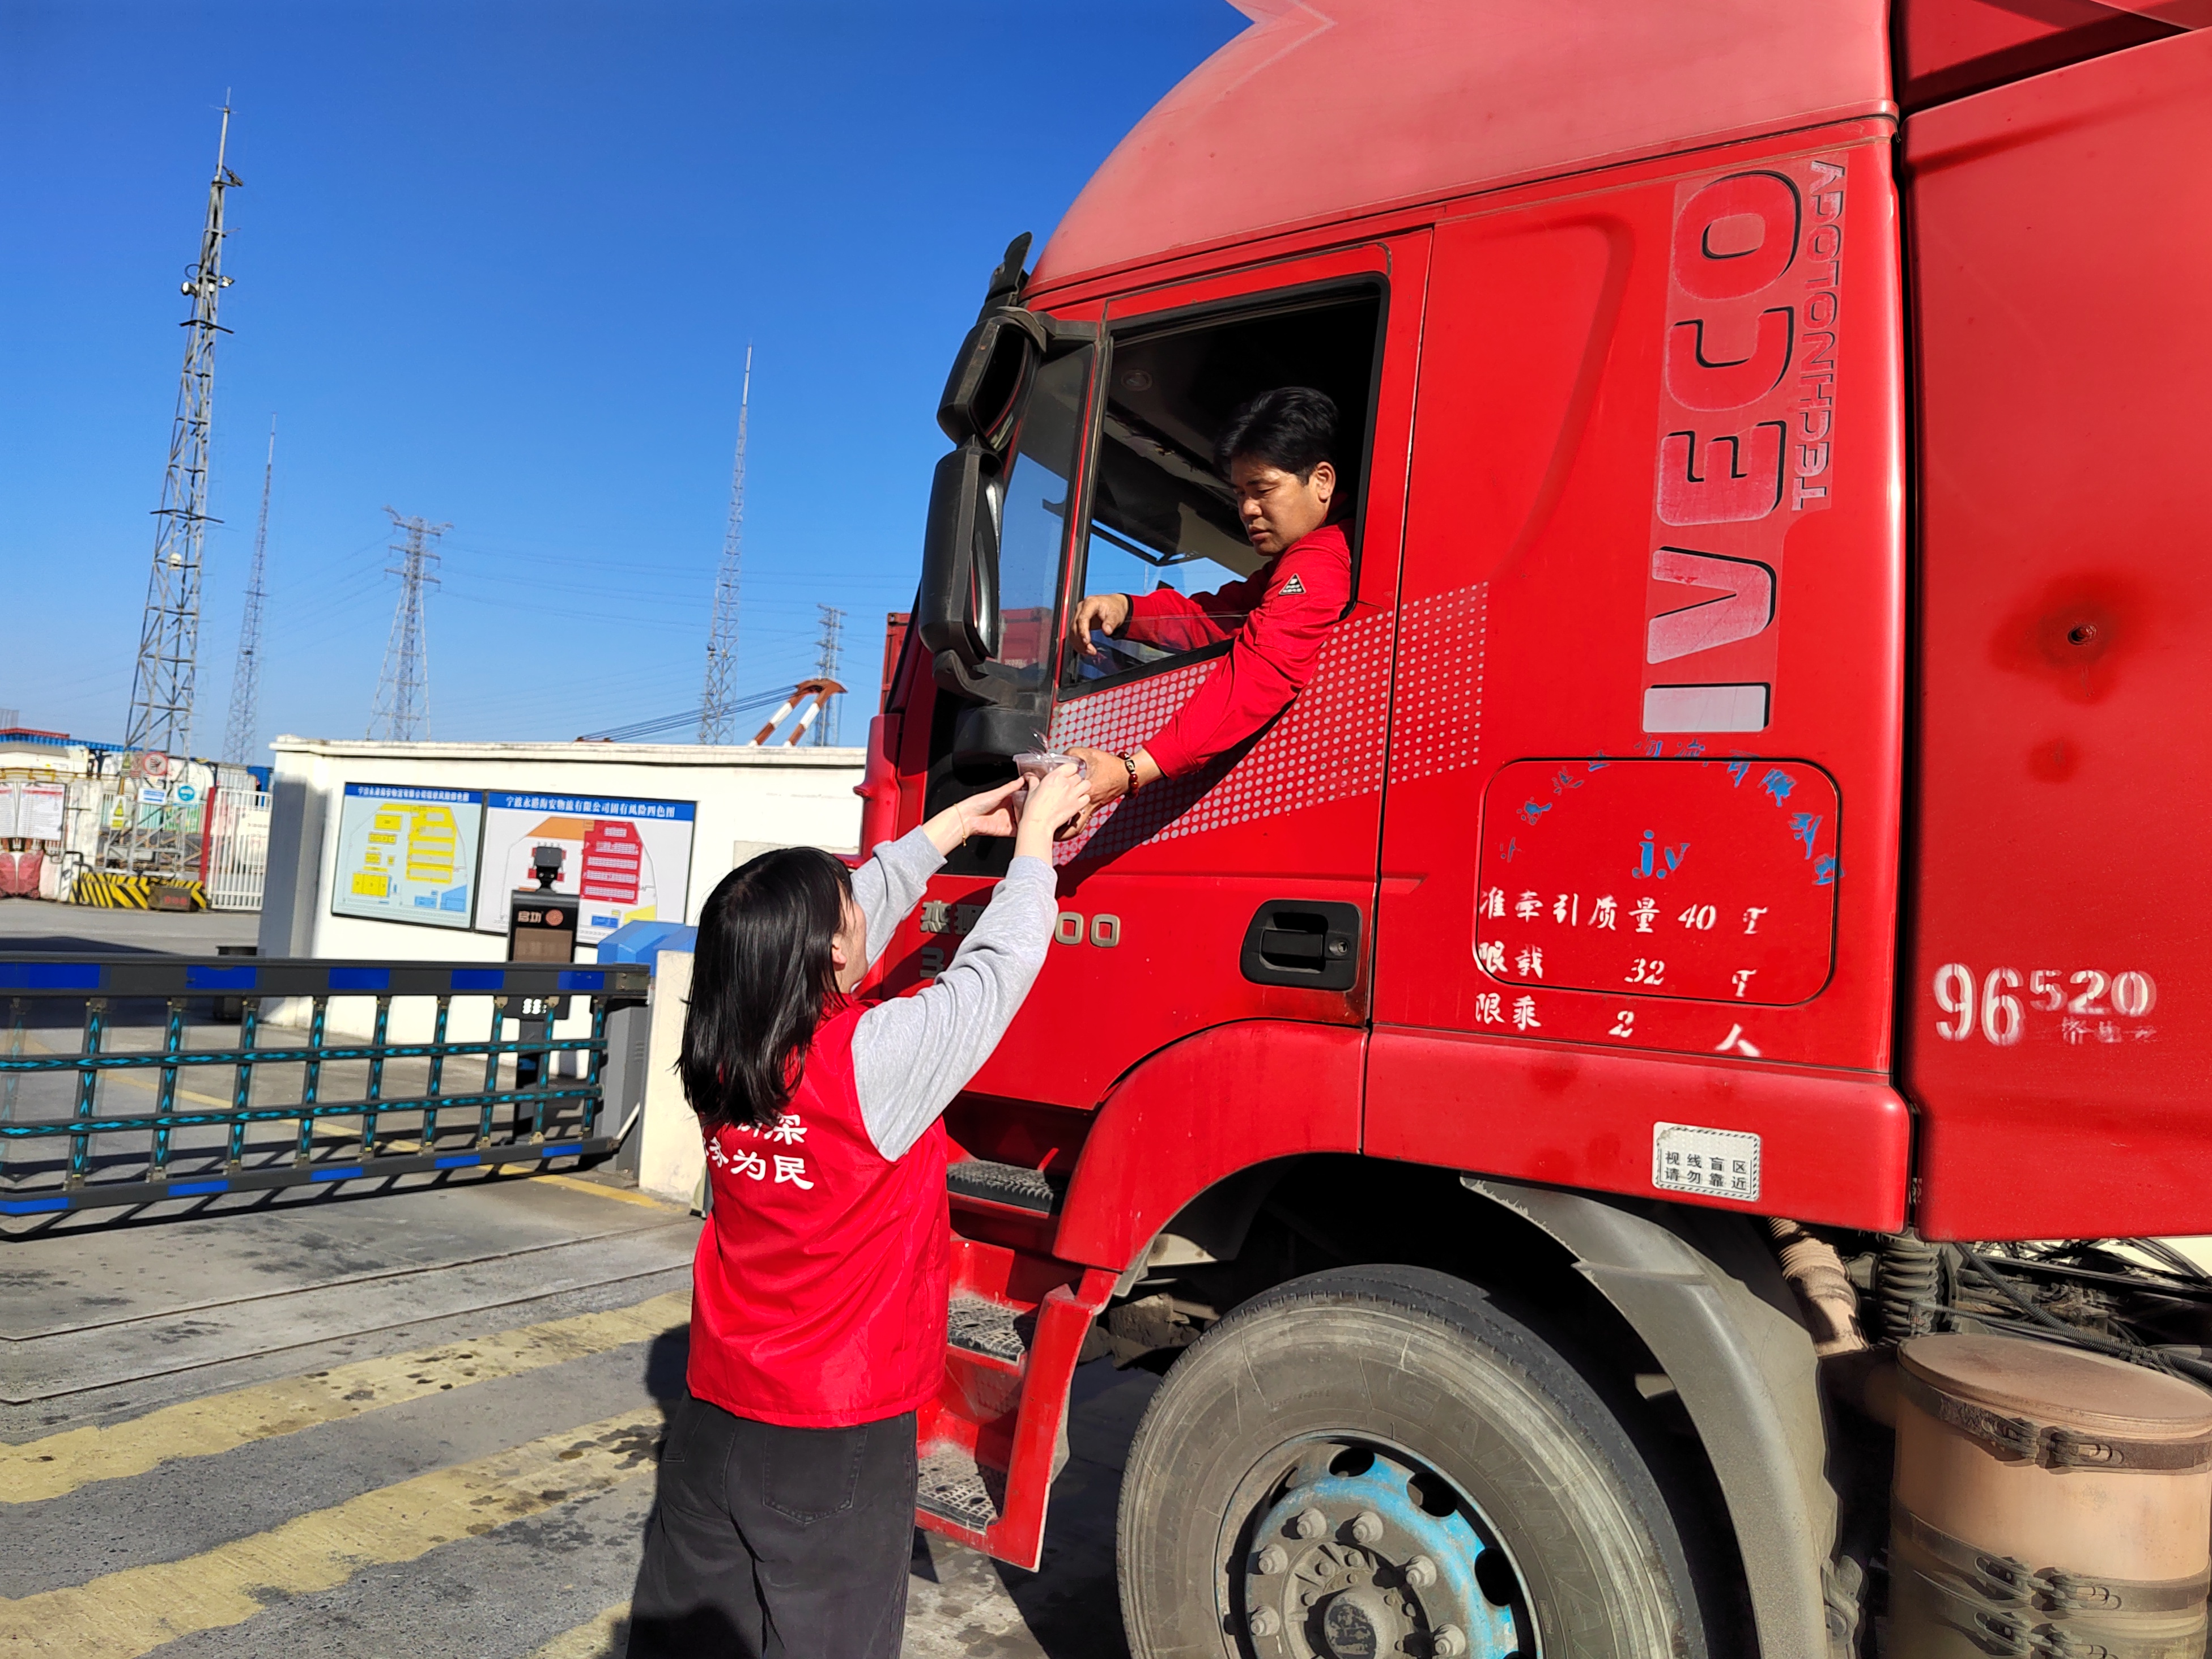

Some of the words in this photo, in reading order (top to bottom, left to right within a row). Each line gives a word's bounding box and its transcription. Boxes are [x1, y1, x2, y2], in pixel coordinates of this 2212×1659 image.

[1792, 160, 1846, 511] TECHNOLOGY
[1643, 170, 1802, 733] IVECO
[1478, 886, 1661, 934] 准牵引质量
[1677, 903, 1717, 930] 40
[1742, 907, 1768, 935] T
[1477, 940, 1543, 980] 限载
[1623, 958, 1665, 986] 32
[1475, 992, 1541, 1031] 限乘
[1608, 1010, 1635, 1039] 2
[1715, 1023, 1761, 1057] 人
[1664, 1167, 1747, 1191] 请勿靠近
[1665, 1151, 1747, 1175] 视线盲区
